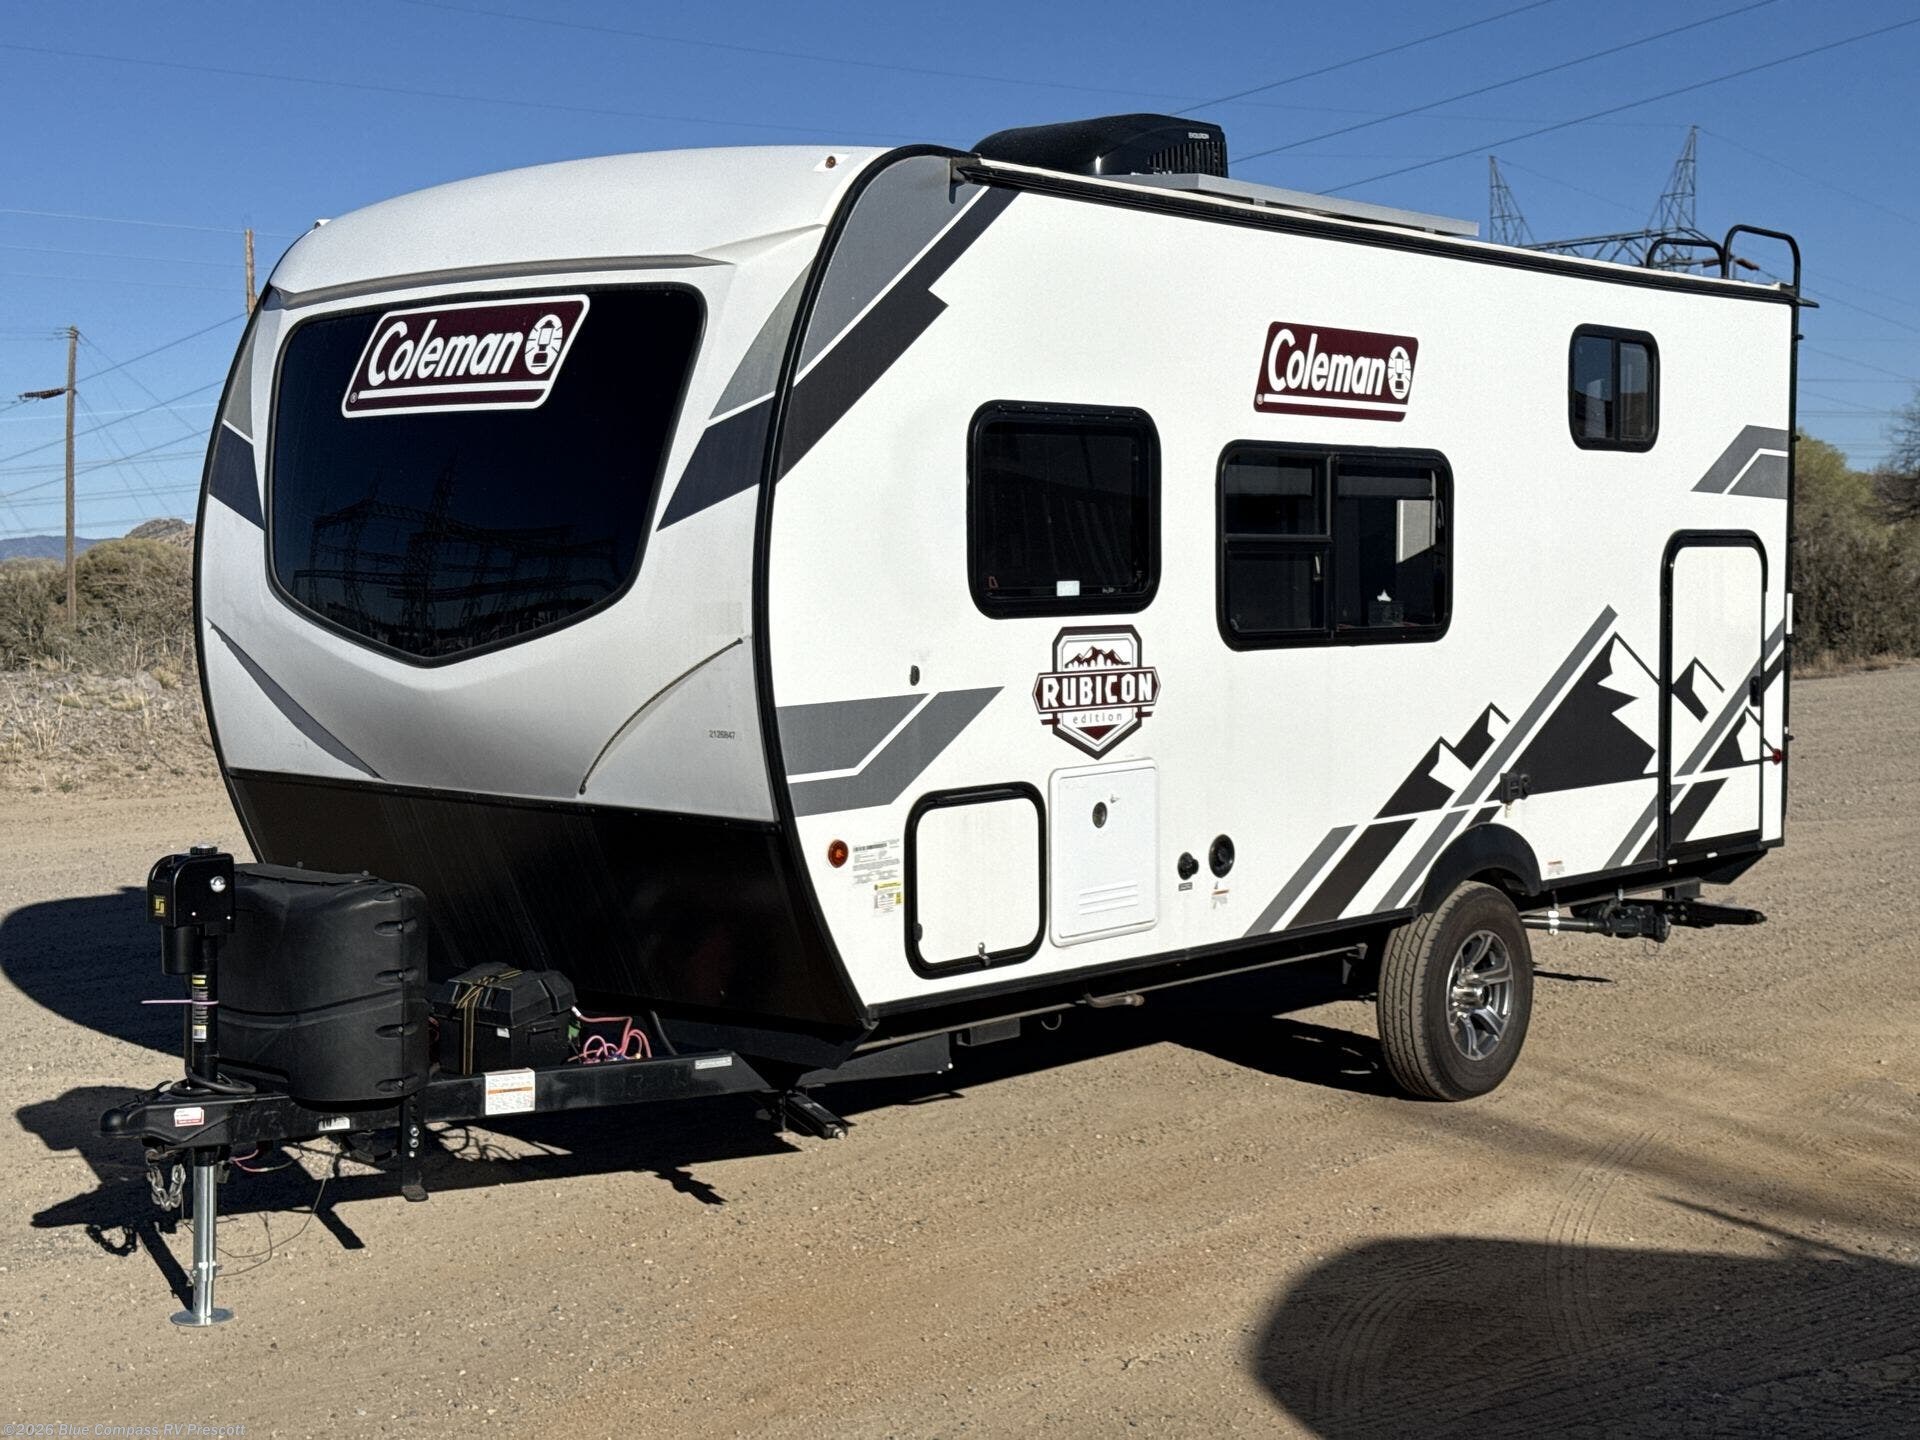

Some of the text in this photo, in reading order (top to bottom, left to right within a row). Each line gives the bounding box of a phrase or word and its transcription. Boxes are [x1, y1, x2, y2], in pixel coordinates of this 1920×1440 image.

[368, 319, 523, 386] Coleman
[1268, 329, 1386, 395] Coleman
[1042, 673, 1152, 708] RUBICON
[1073, 713, 1122, 724] edition
